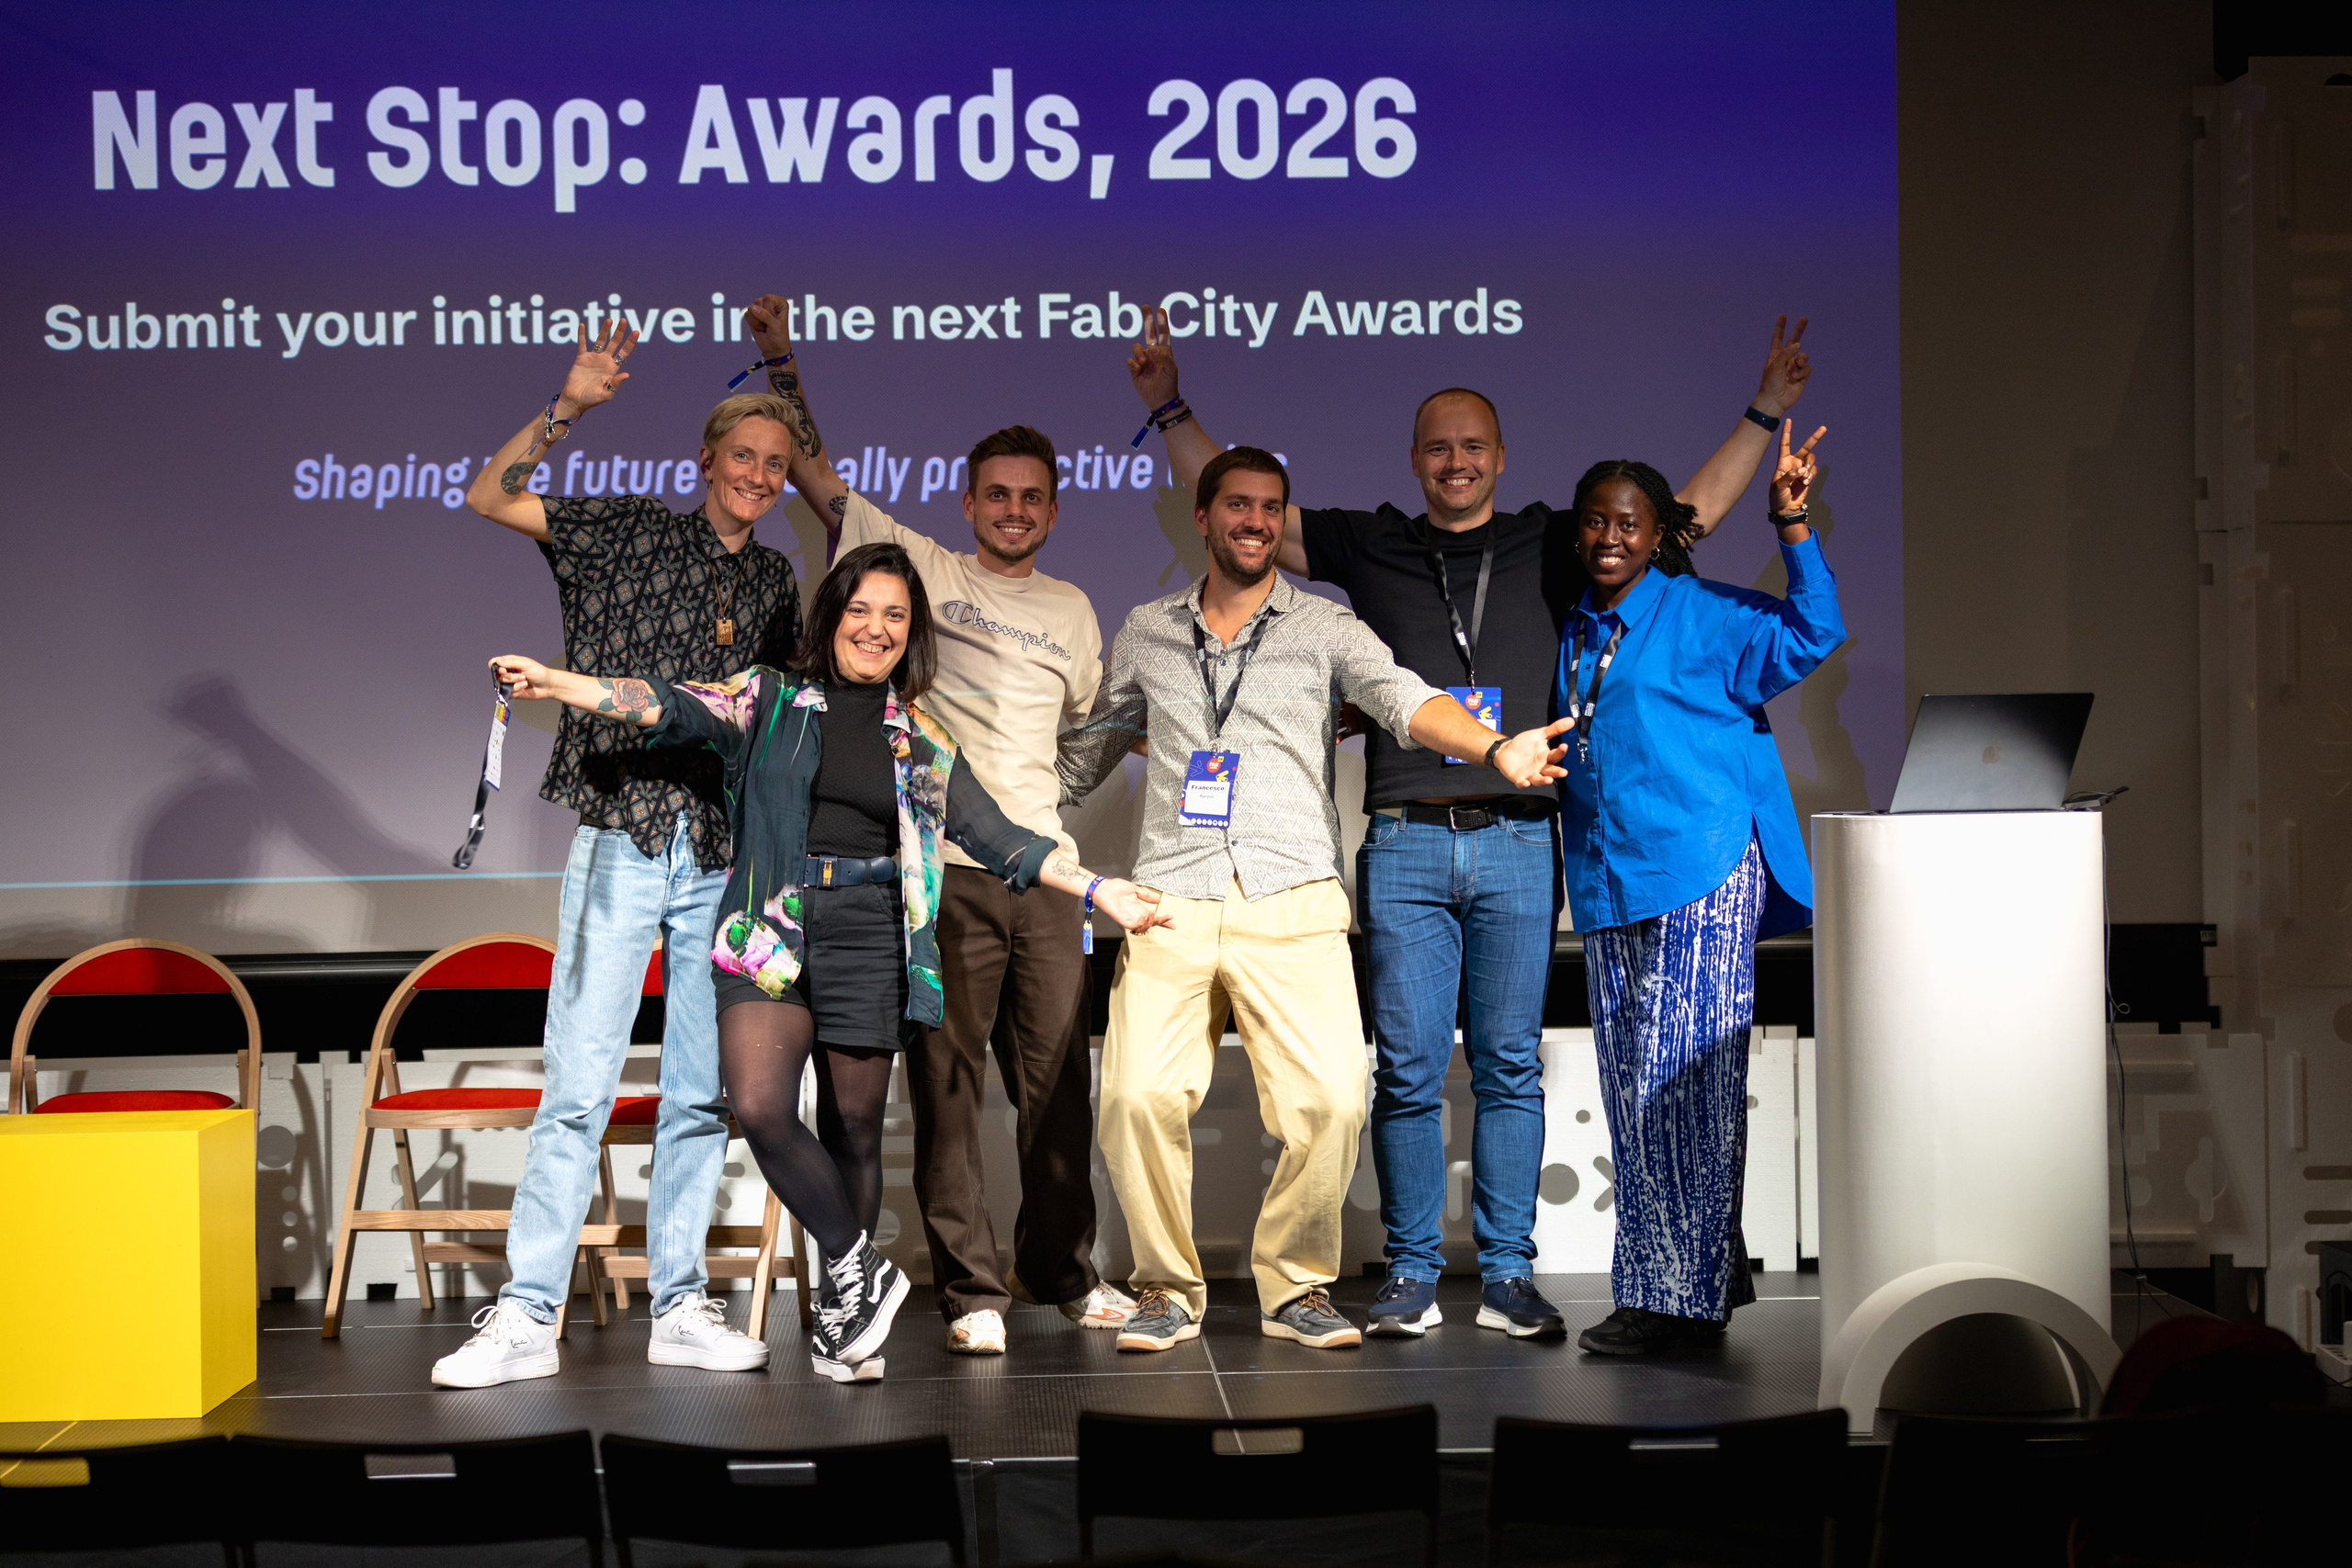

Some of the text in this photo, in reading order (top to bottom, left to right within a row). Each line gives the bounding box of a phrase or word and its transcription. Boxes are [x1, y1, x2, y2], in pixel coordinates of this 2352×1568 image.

[93, 68, 1418, 213] Next Stop: Awards, 2026
[43, 298, 262, 351] Submit
[276, 310, 417, 358] your
[433, 293, 695, 345] initiative
[787, 294, 876, 342] the
[893, 296, 1023, 341] next
[1038, 291, 1144, 339] Fab
[1159, 288, 1279, 348] City
[1293, 287, 1523, 336] Awards
[293, 454, 471, 510] Shaping
[564, 450, 698, 496] future
[942, 600, 1071, 660] Champion
